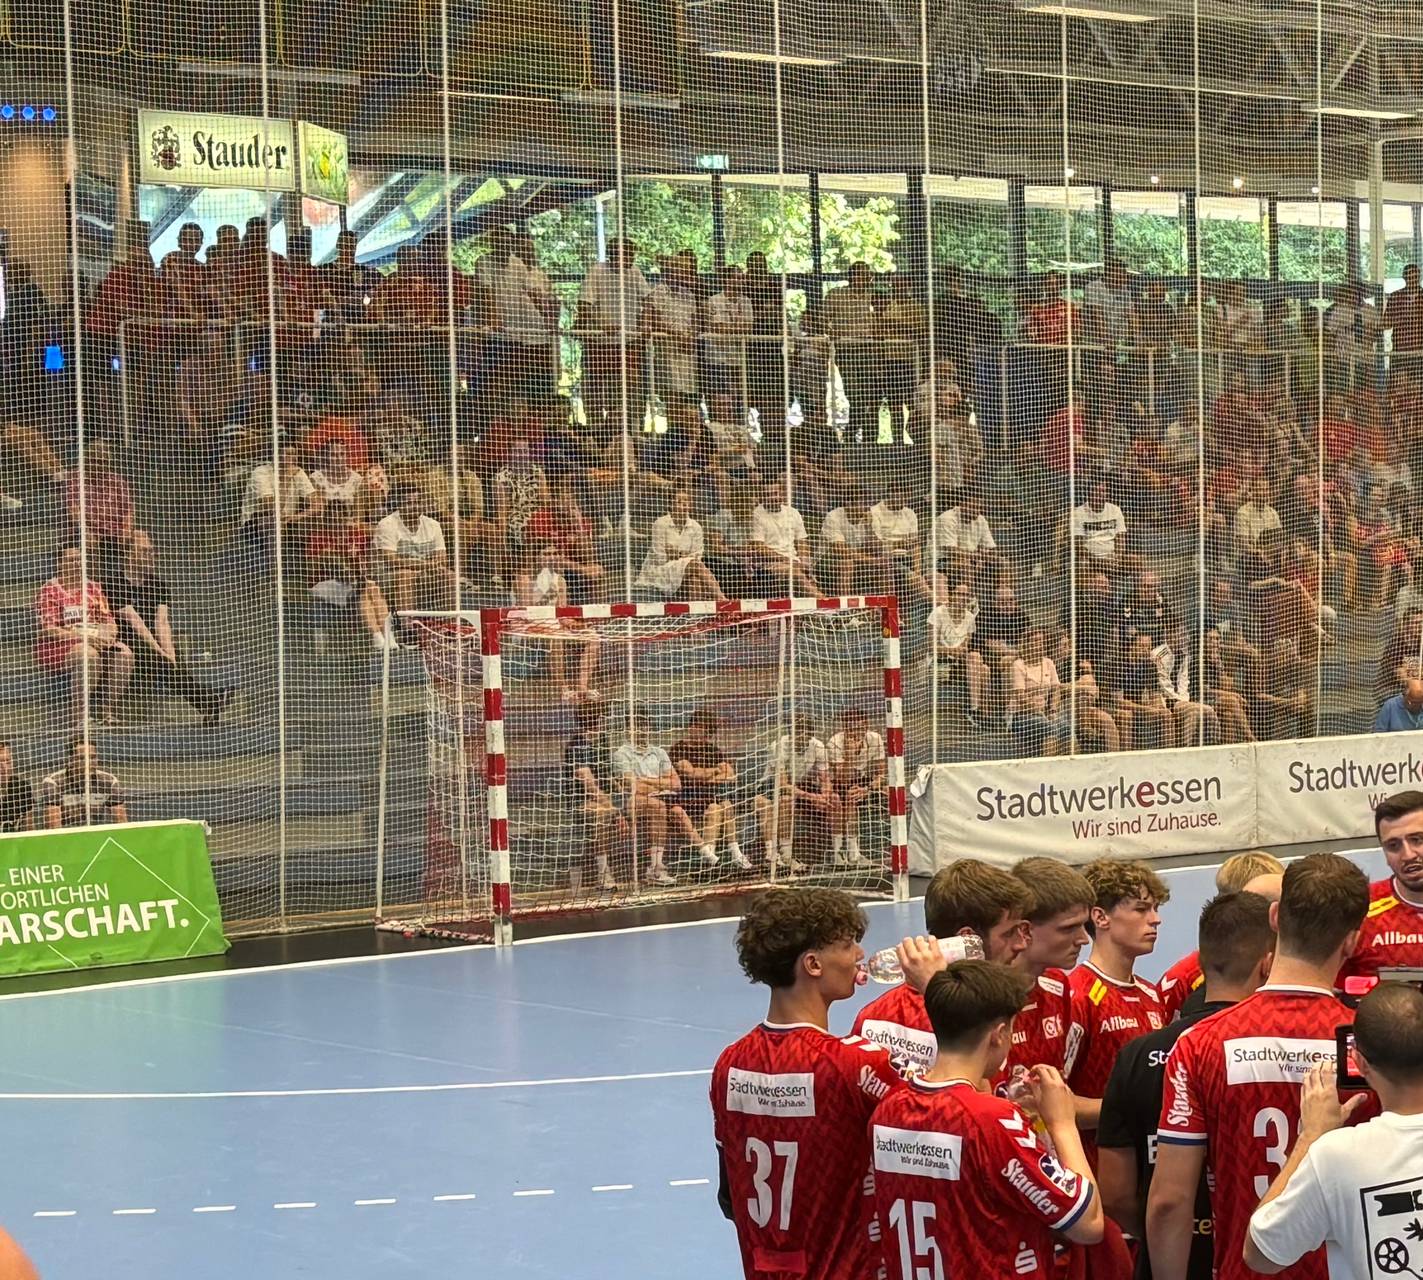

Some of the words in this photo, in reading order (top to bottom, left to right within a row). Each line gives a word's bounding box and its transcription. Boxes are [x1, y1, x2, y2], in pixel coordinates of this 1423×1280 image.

[192, 130, 287, 171] Stauder
[976, 776, 1222, 821] Stadtwerkessen
[1072, 819, 1102, 840] Wir
[1107, 815, 1142, 836] sind
[1147, 811, 1222, 833] Zuhause.
[9, 864, 65, 887] EINER
[1100, 1016, 1139, 1034] Allbau
[1233, 1047, 1338, 1064] Stadtwerkess
[857, 1064, 891, 1100] Stau
[1166, 1061, 1193, 1127] Stauder
[745, 1136, 799, 1231] 37
[1000, 1157, 1060, 1216] Stauder
[888, 1198, 945, 1280] 15
